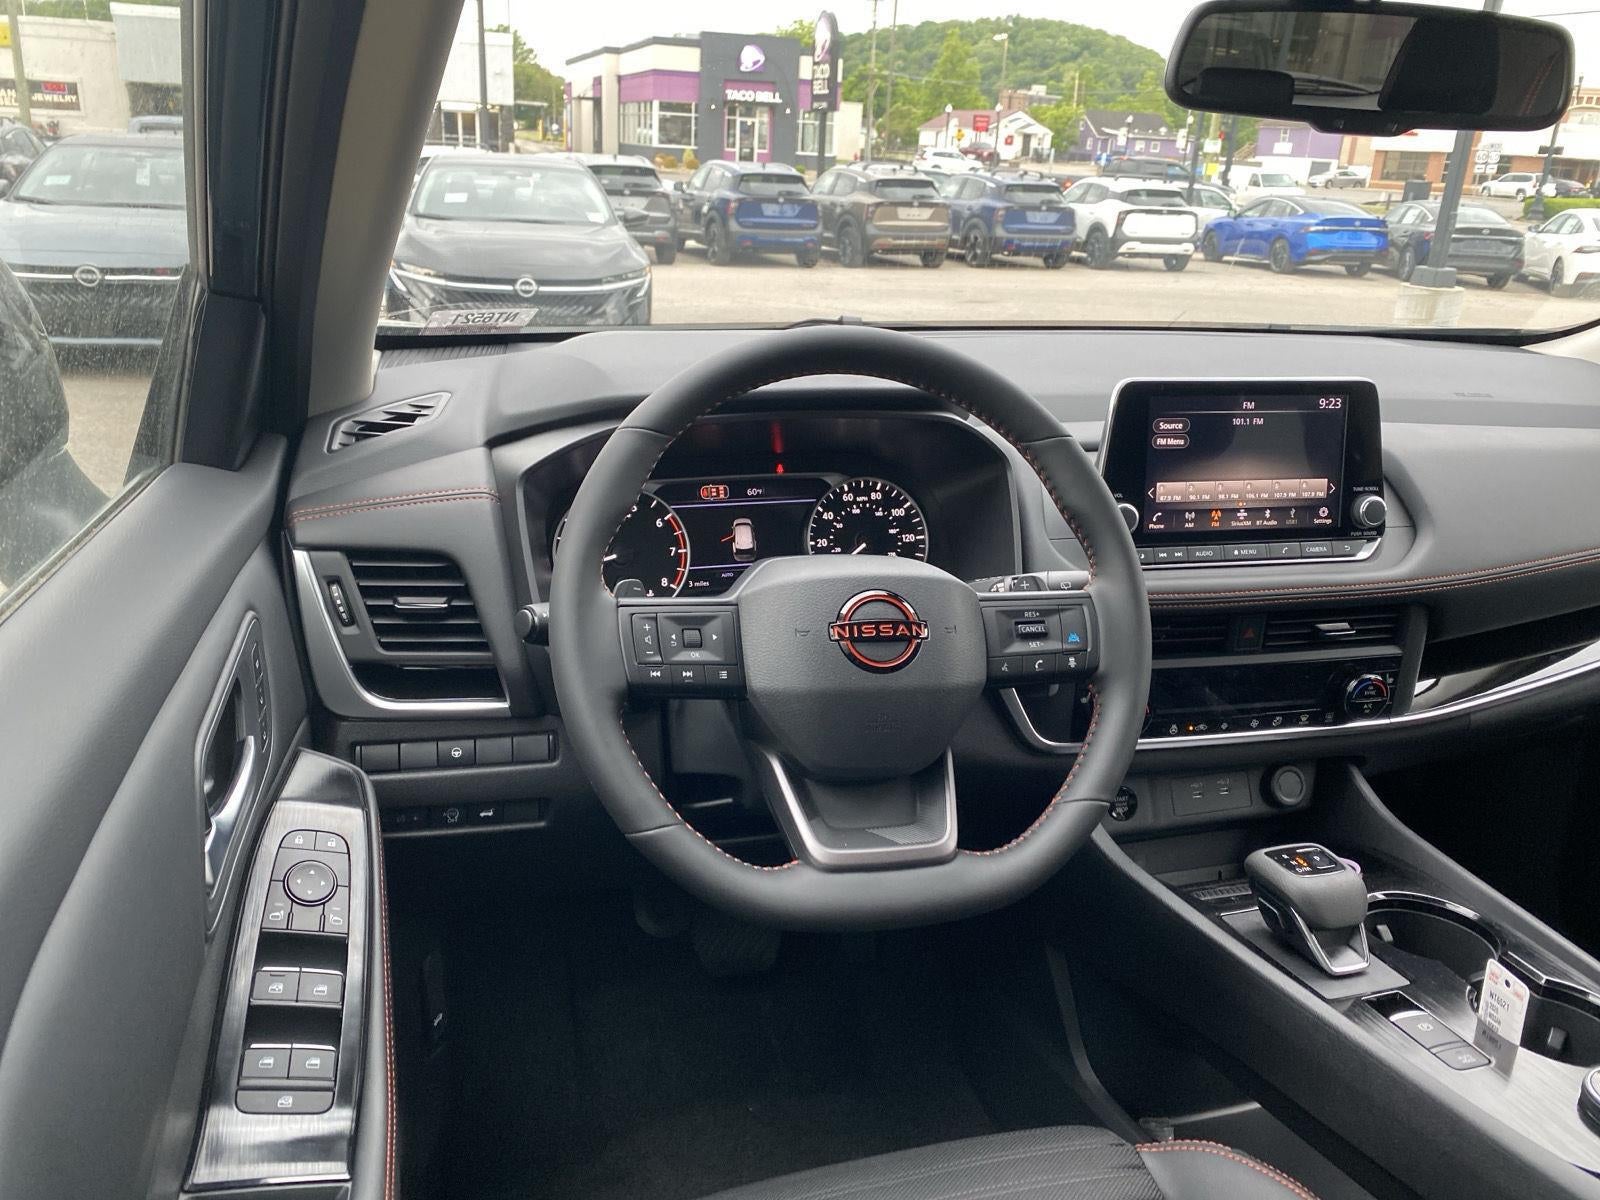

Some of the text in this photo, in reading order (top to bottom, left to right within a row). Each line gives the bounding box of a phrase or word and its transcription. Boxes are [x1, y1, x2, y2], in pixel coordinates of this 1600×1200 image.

[32, 93, 77, 102] JEWELRY
[725, 89, 782, 103] TACO BELL
[1242, 401, 1255, 410] FM
[1319, 398, 1341, 409] 9:23
[1159, 422, 1183, 430] Source
[1232, 417, 1264, 426] 101.1 FM
[1156, 438, 1185, 446] FM Menu
[842, 493, 854, 501] 60
[870, 492, 882, 500] 80
[822, 511, 834, 520] 40
[891, 508, 905, 516] 100
[656, 518, 663, 528] 6
[902, 534, 915, 542] 120
[816, 539, 828, 547] 20
[669, 547, 676, 556] 7
[661, 577, 668, 587] 8
[832, 623, 926, 640] NISSAN
